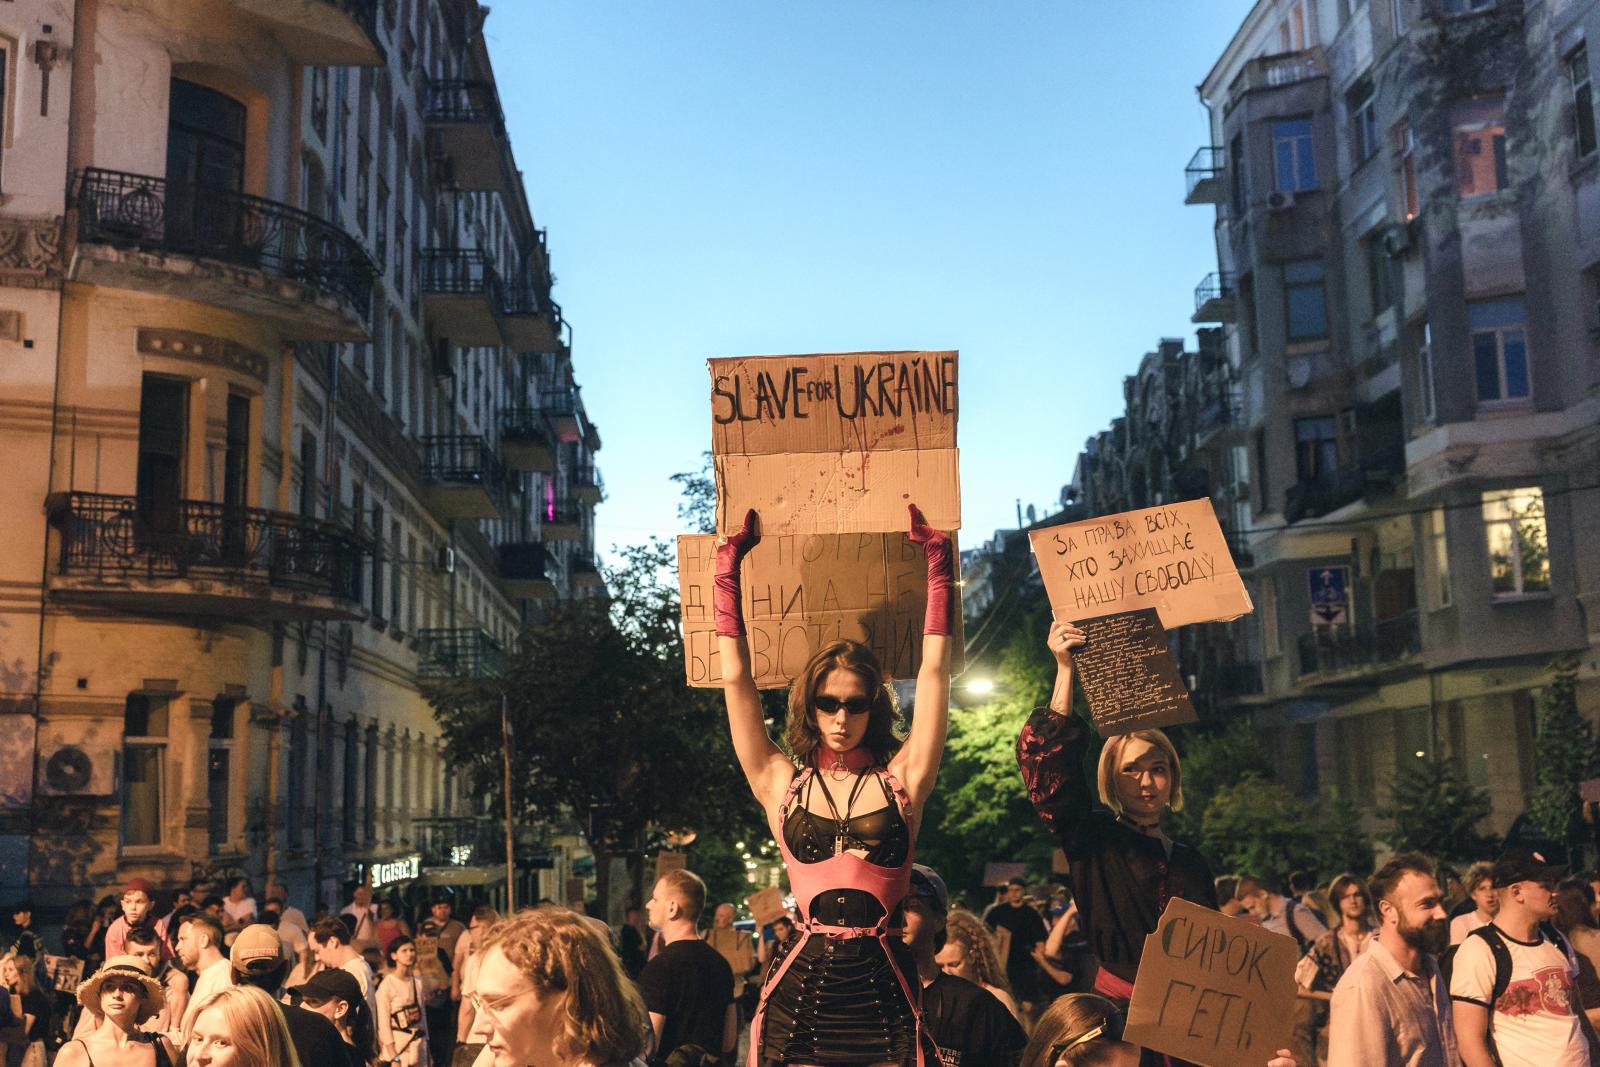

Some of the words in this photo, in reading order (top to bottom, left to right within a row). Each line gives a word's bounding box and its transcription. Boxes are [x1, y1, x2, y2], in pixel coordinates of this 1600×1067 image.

[714, 366, 809, 424] SLAVE
[833, 357, 957, 419] UKRAINE
[686, 540, 754, 576] НА
[1053, 532, 1078, 556] ЗА
[1084, 520, 1136, 547] ПРАВА
[1065, 556, 1099, 582] ХТО
[1107, 532, 1195, 572] ЗАХИЩАЄ
[1073, 576, 1126, 609] НАШУ
[1134, 555, 1216, 596] СВОБОДУ
[1161, 917, 1271, 991] СИРОК
[1158, 979, 1252, 1049] ГЕТЬ
